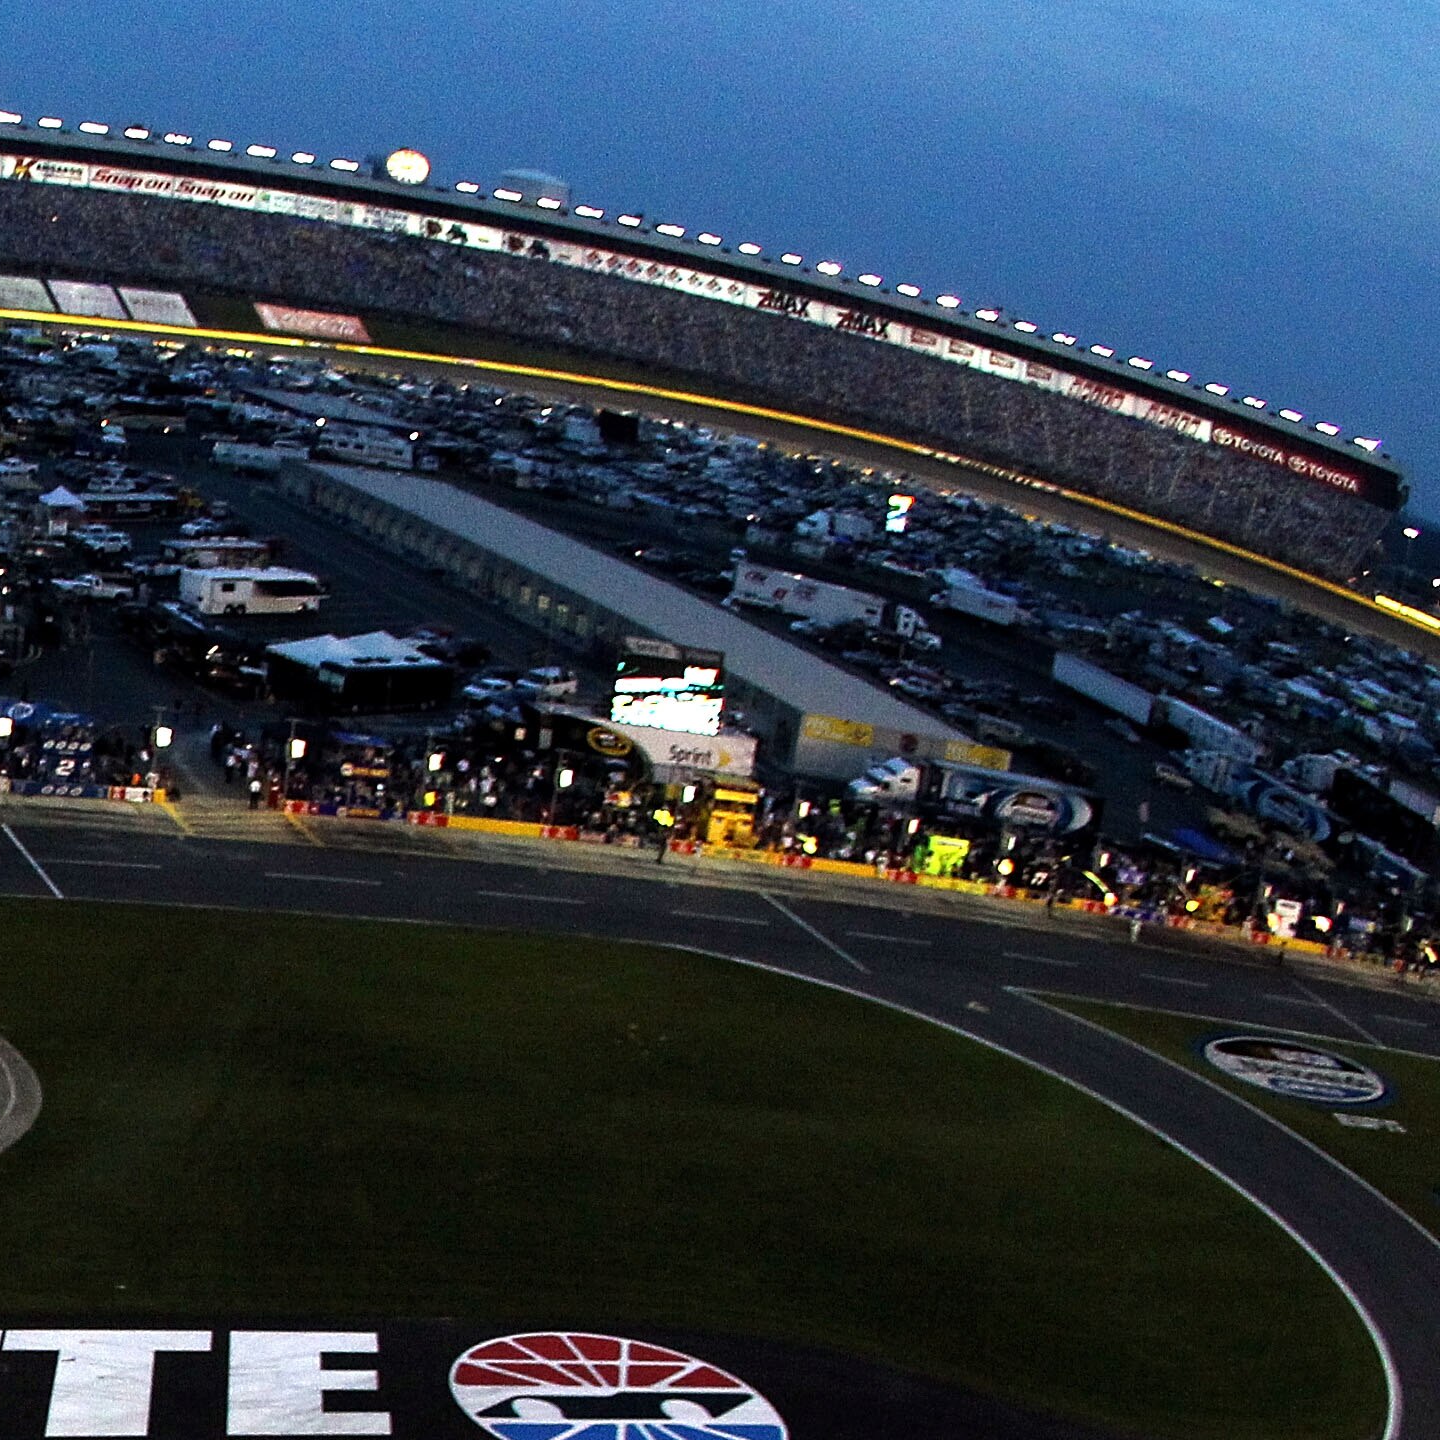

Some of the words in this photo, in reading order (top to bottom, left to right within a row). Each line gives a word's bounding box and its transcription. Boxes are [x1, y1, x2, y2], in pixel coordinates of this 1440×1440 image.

[1230, 434, 1286, 465] TOYOTA
[1307, 463, 1360, 492] TOYOTA
[55, 759, 75, 777] 2
[670, 745, 713, 766] Sprint
